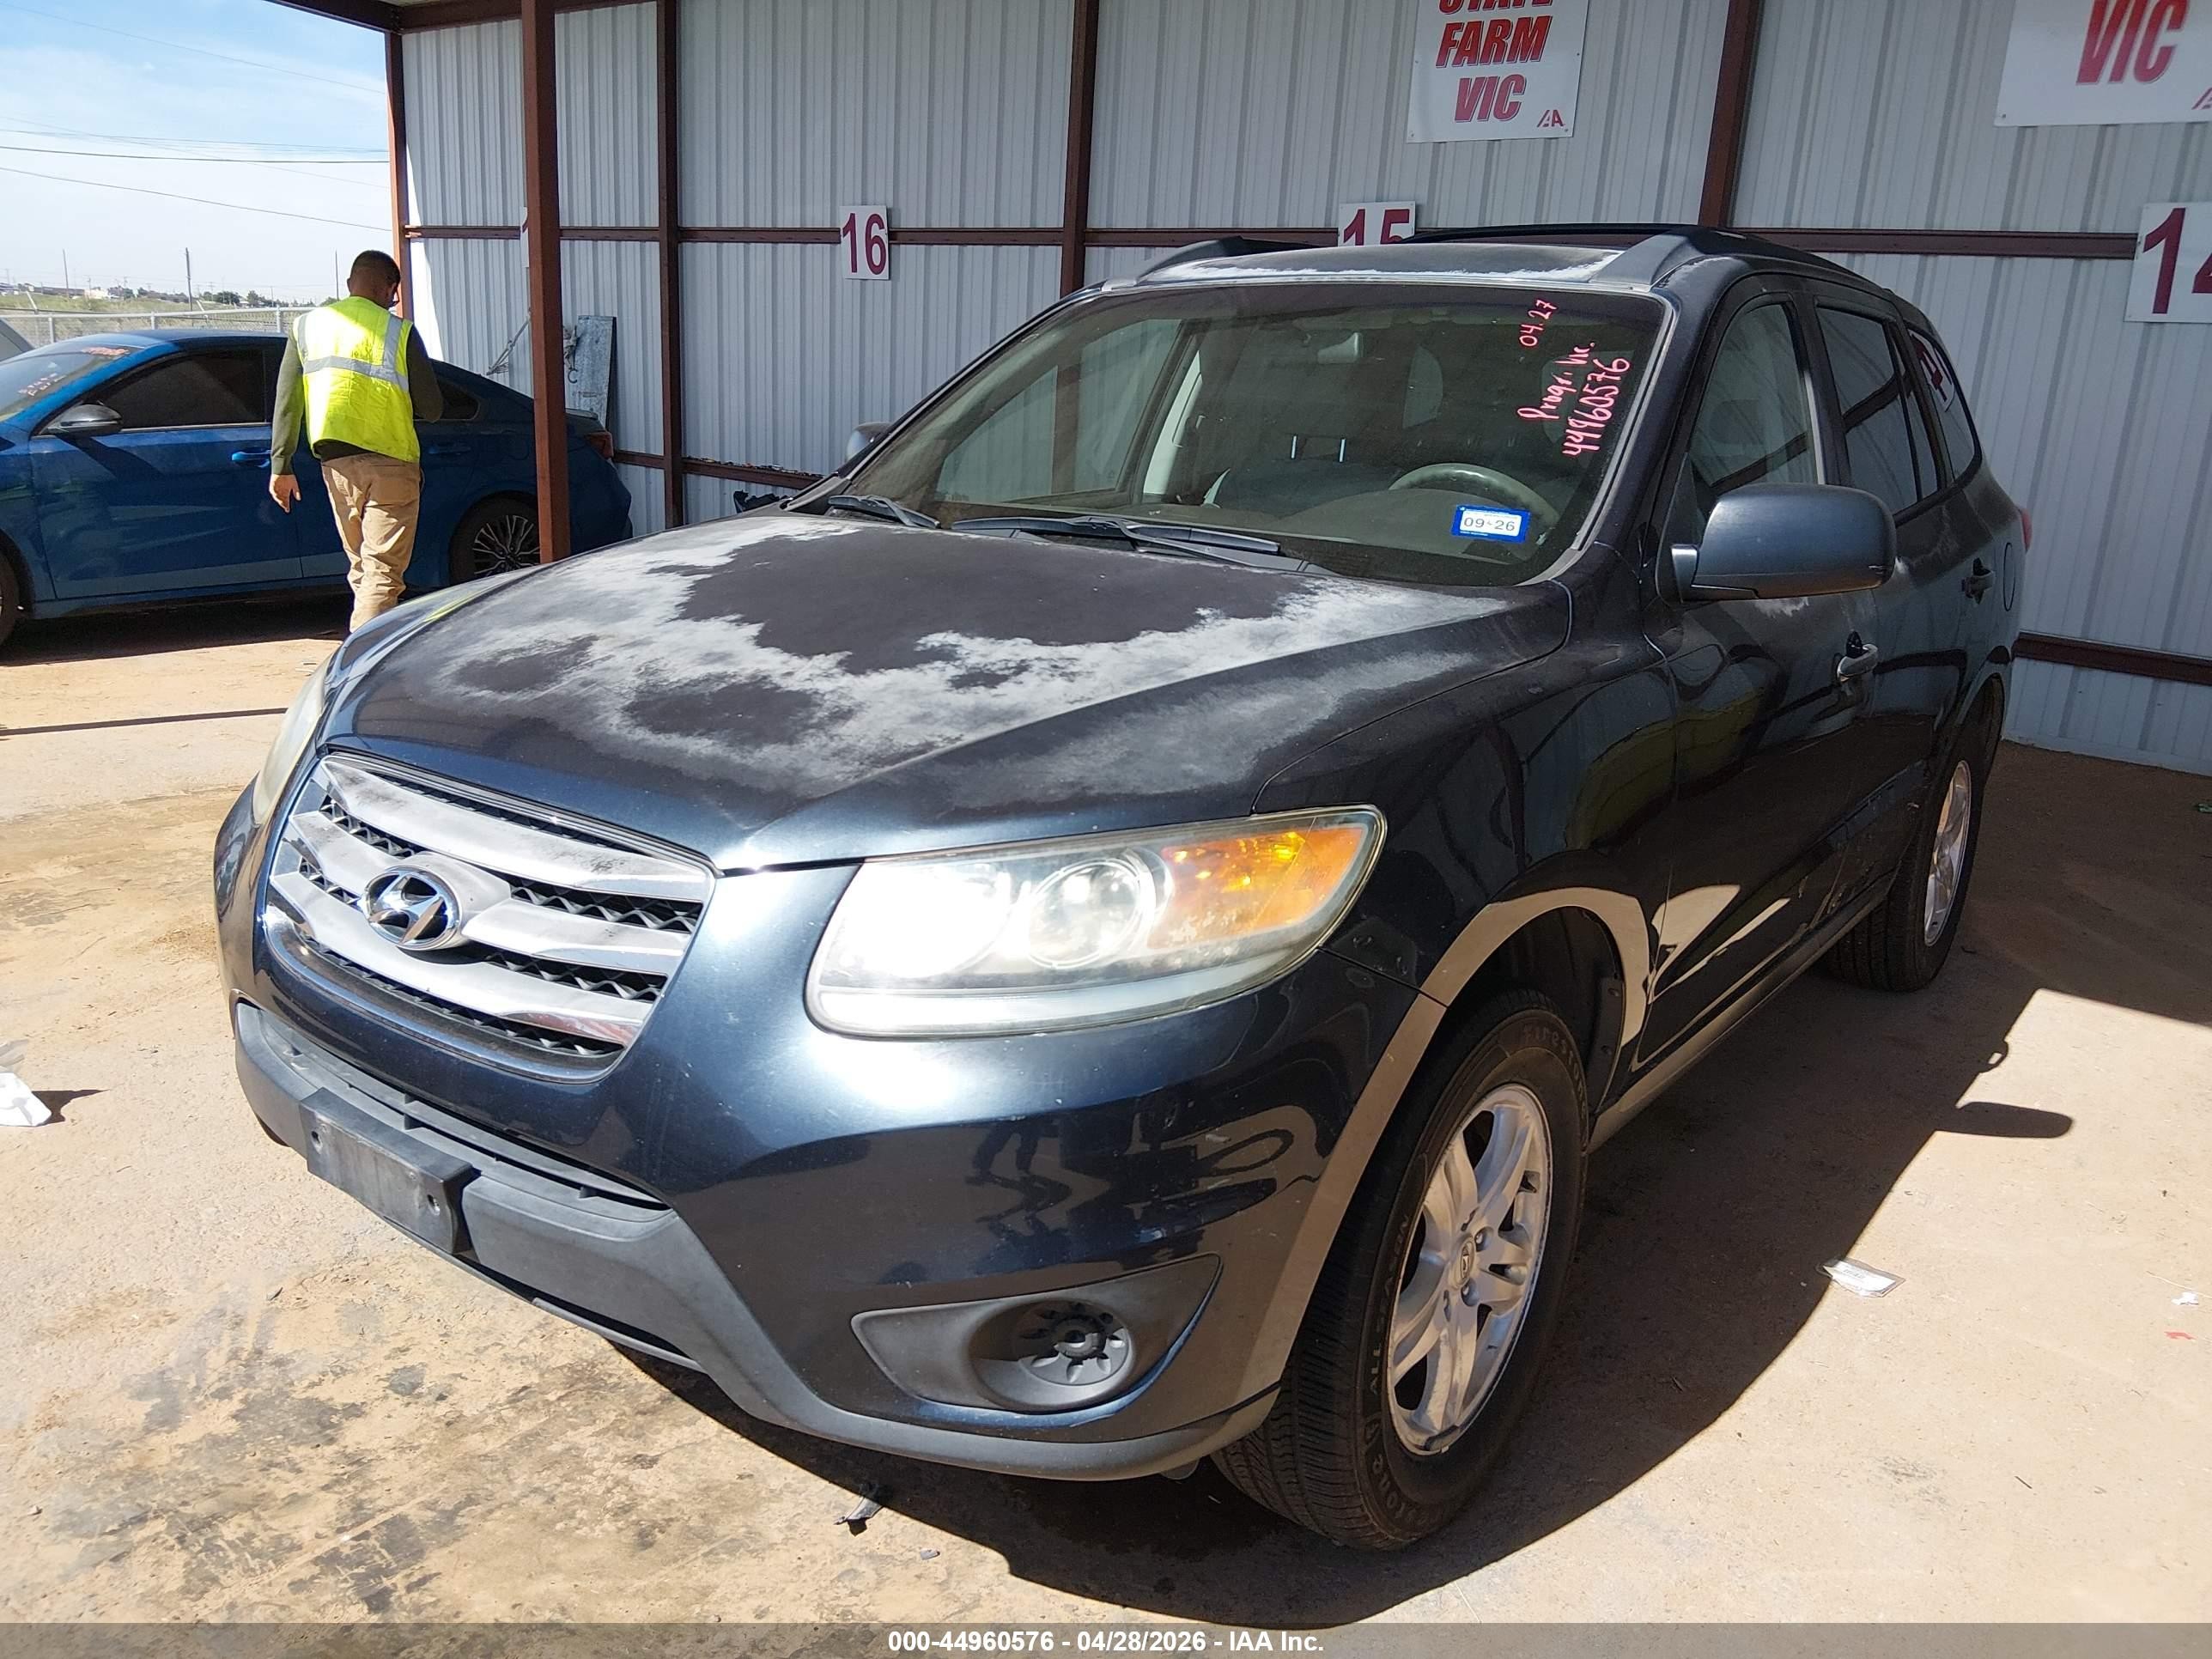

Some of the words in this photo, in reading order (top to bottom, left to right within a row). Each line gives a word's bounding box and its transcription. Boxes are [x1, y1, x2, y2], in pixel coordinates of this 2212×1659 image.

[1436, 15, 1553, 68] FARM
[2075, 0, 2190, 86] VIC
[1455, 74, 1527, 123] VIC
[842, 213, 887, 275] 16
[1562, 357, 1631, 456] 44960576
